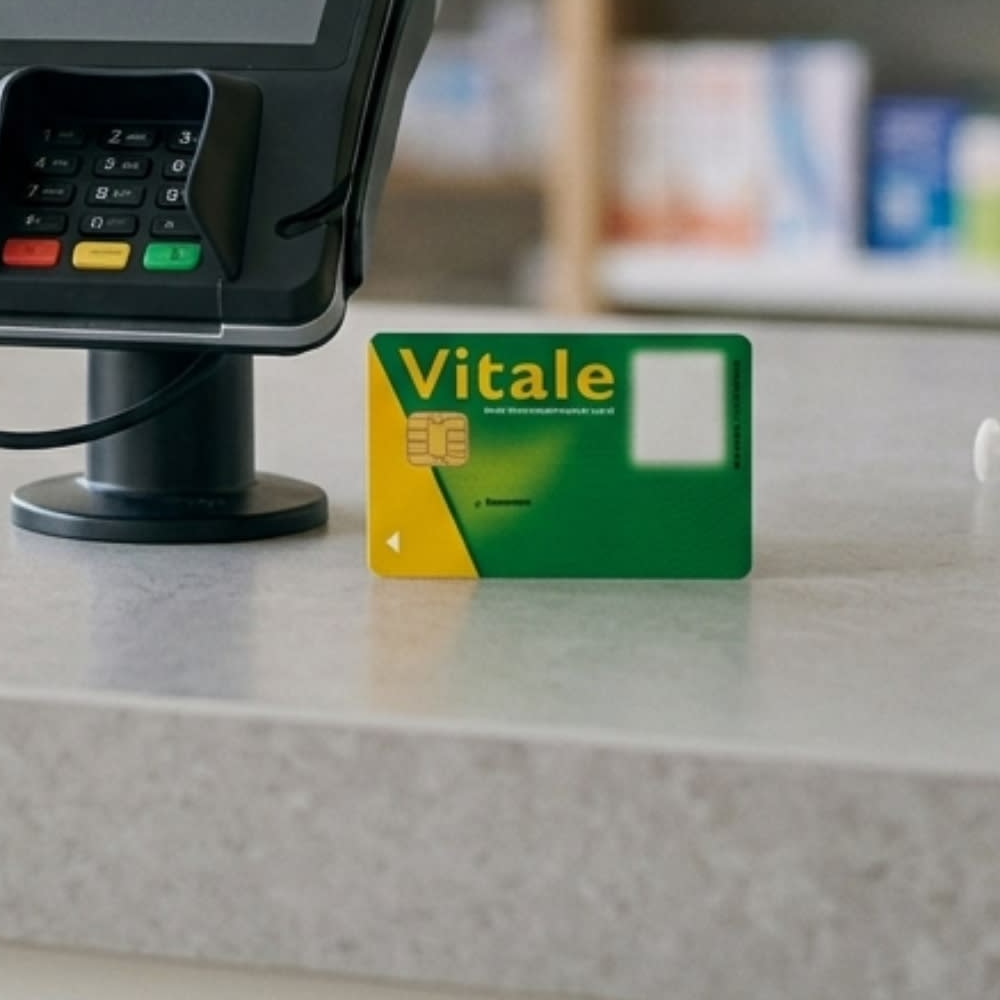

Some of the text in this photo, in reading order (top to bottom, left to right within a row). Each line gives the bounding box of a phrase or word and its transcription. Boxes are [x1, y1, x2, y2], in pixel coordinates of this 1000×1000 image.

[108, 129, 123, 144] 2
[179, 131, 191, 144] 3
[34, 157, 46, 168] 4
[27, 184, 40, 197] 7
[95, 186, 109, 200] 8
[399, 347, 615, 401] Vitale
